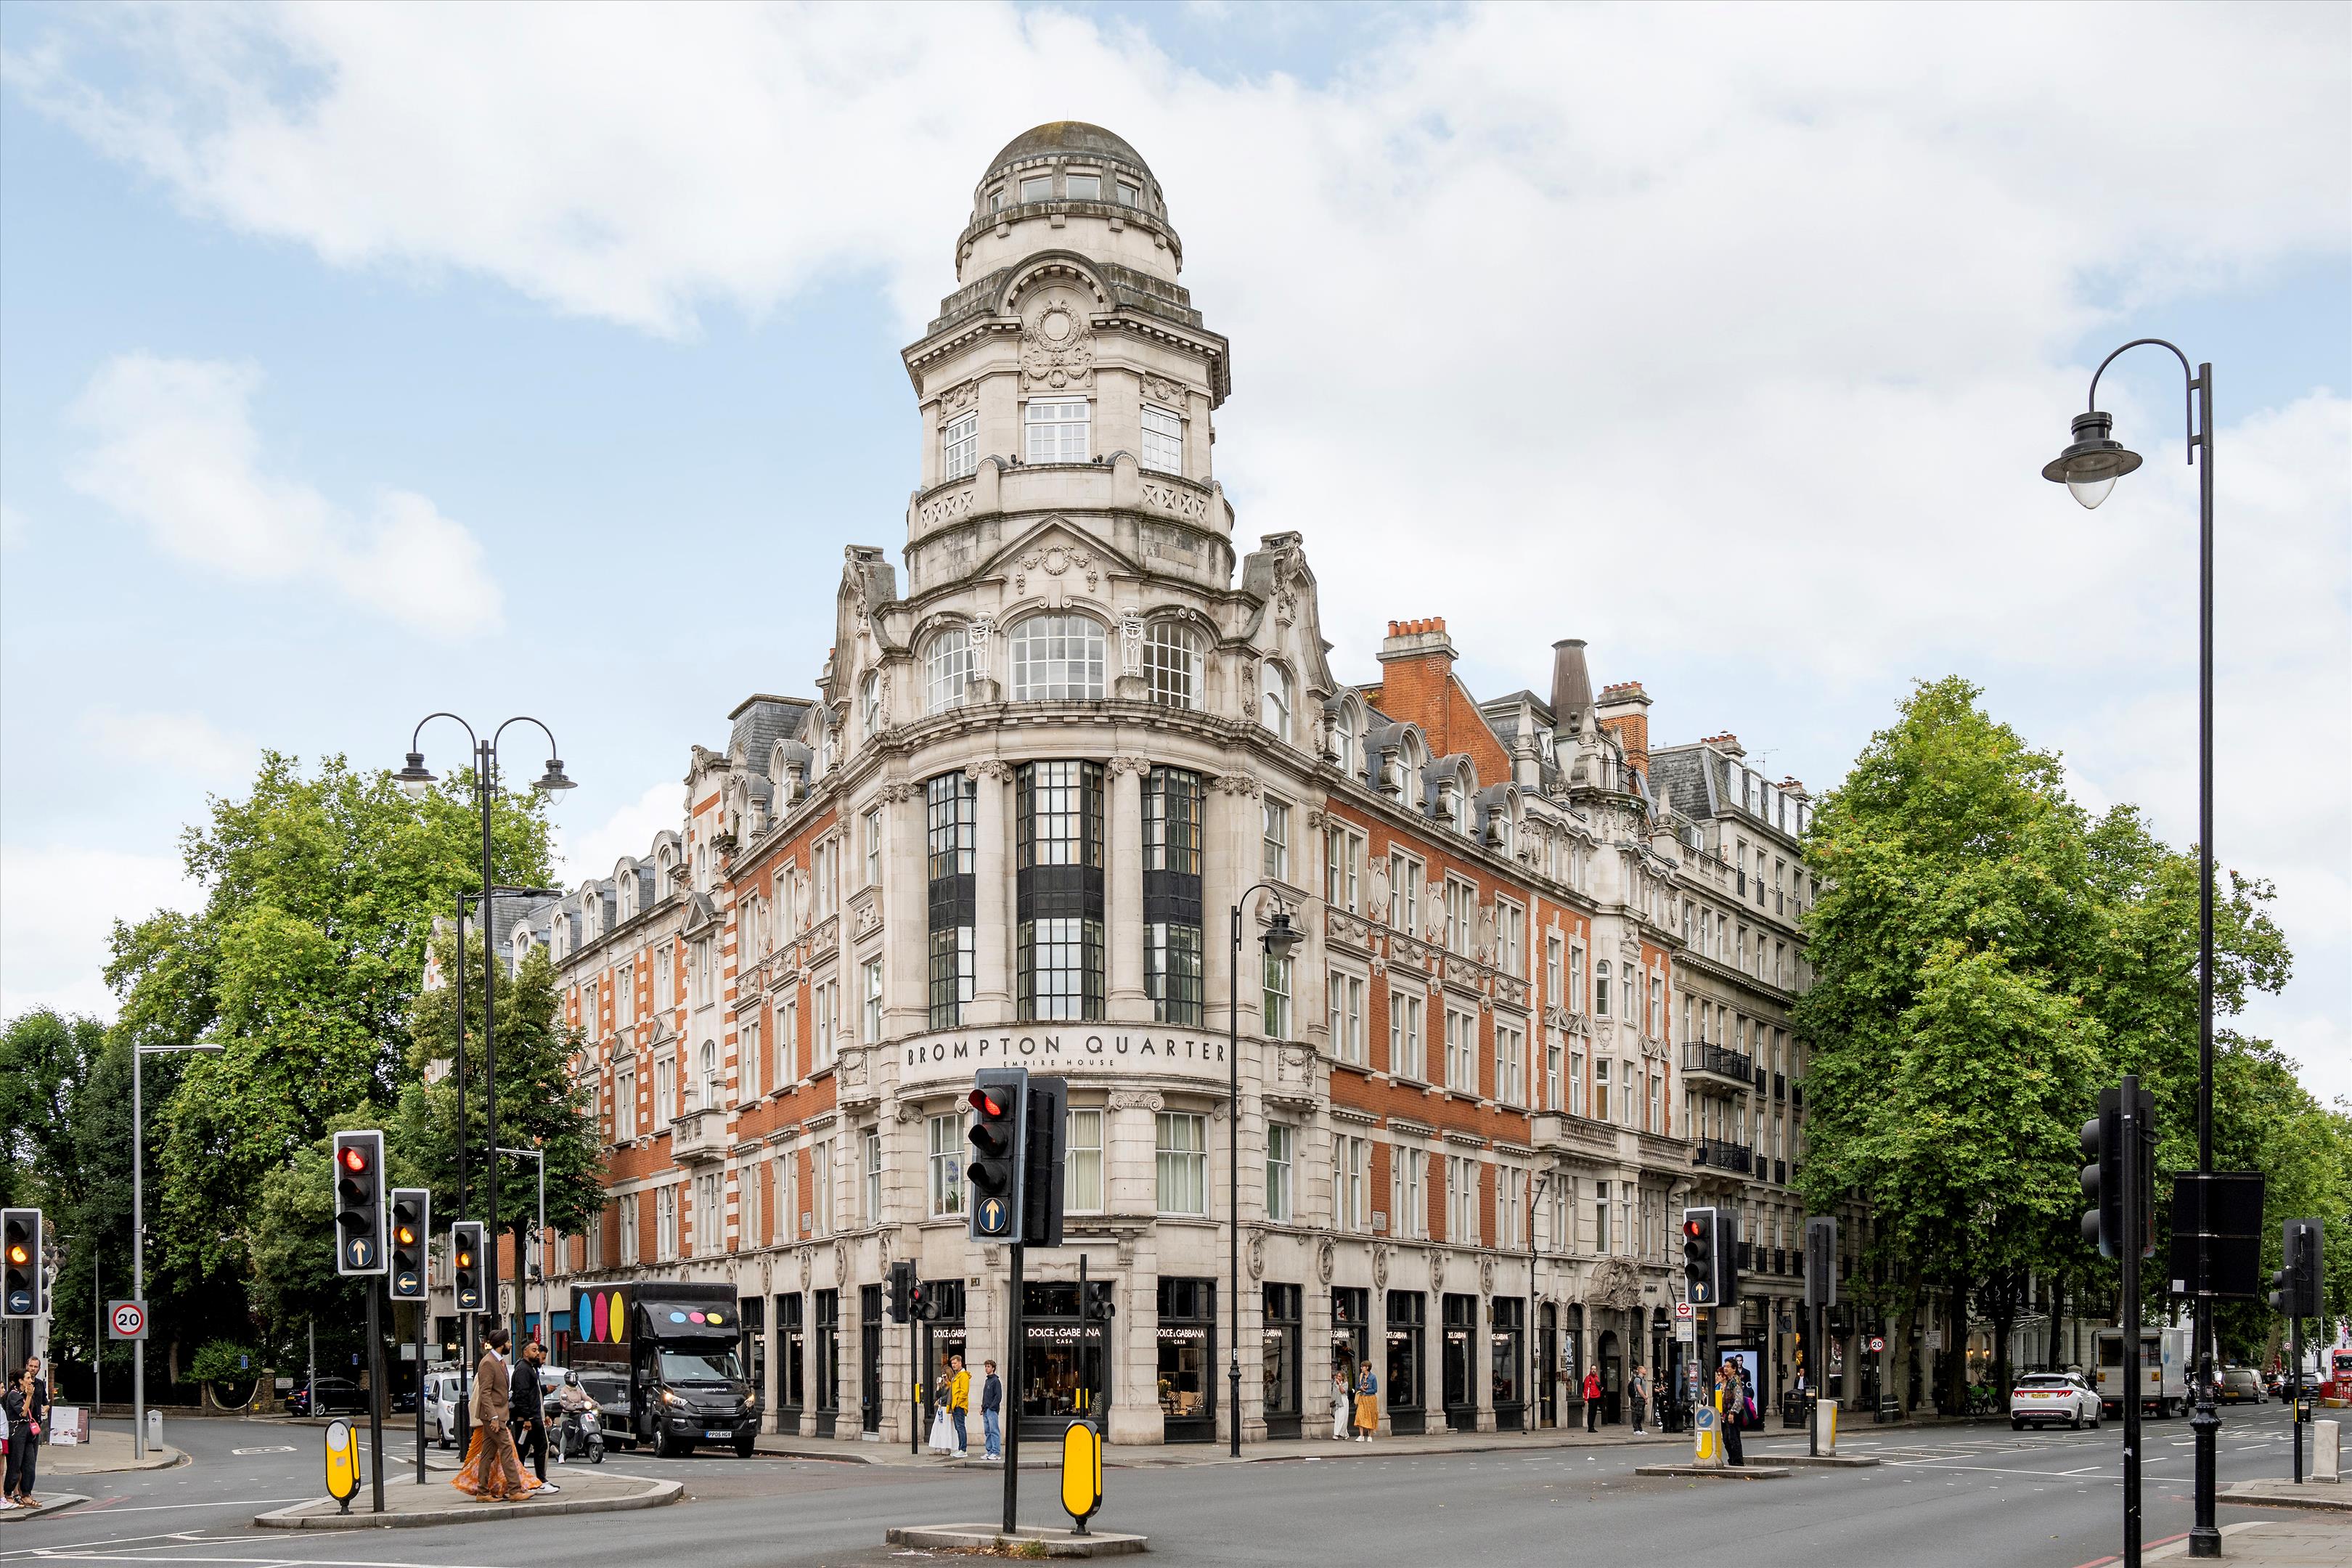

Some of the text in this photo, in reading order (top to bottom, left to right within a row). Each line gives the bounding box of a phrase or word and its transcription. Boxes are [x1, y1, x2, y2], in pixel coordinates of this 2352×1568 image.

[907, 1035, 1224, 1066] BROMPTON QUARTER
[118, 1313, 139, 1326] 20
